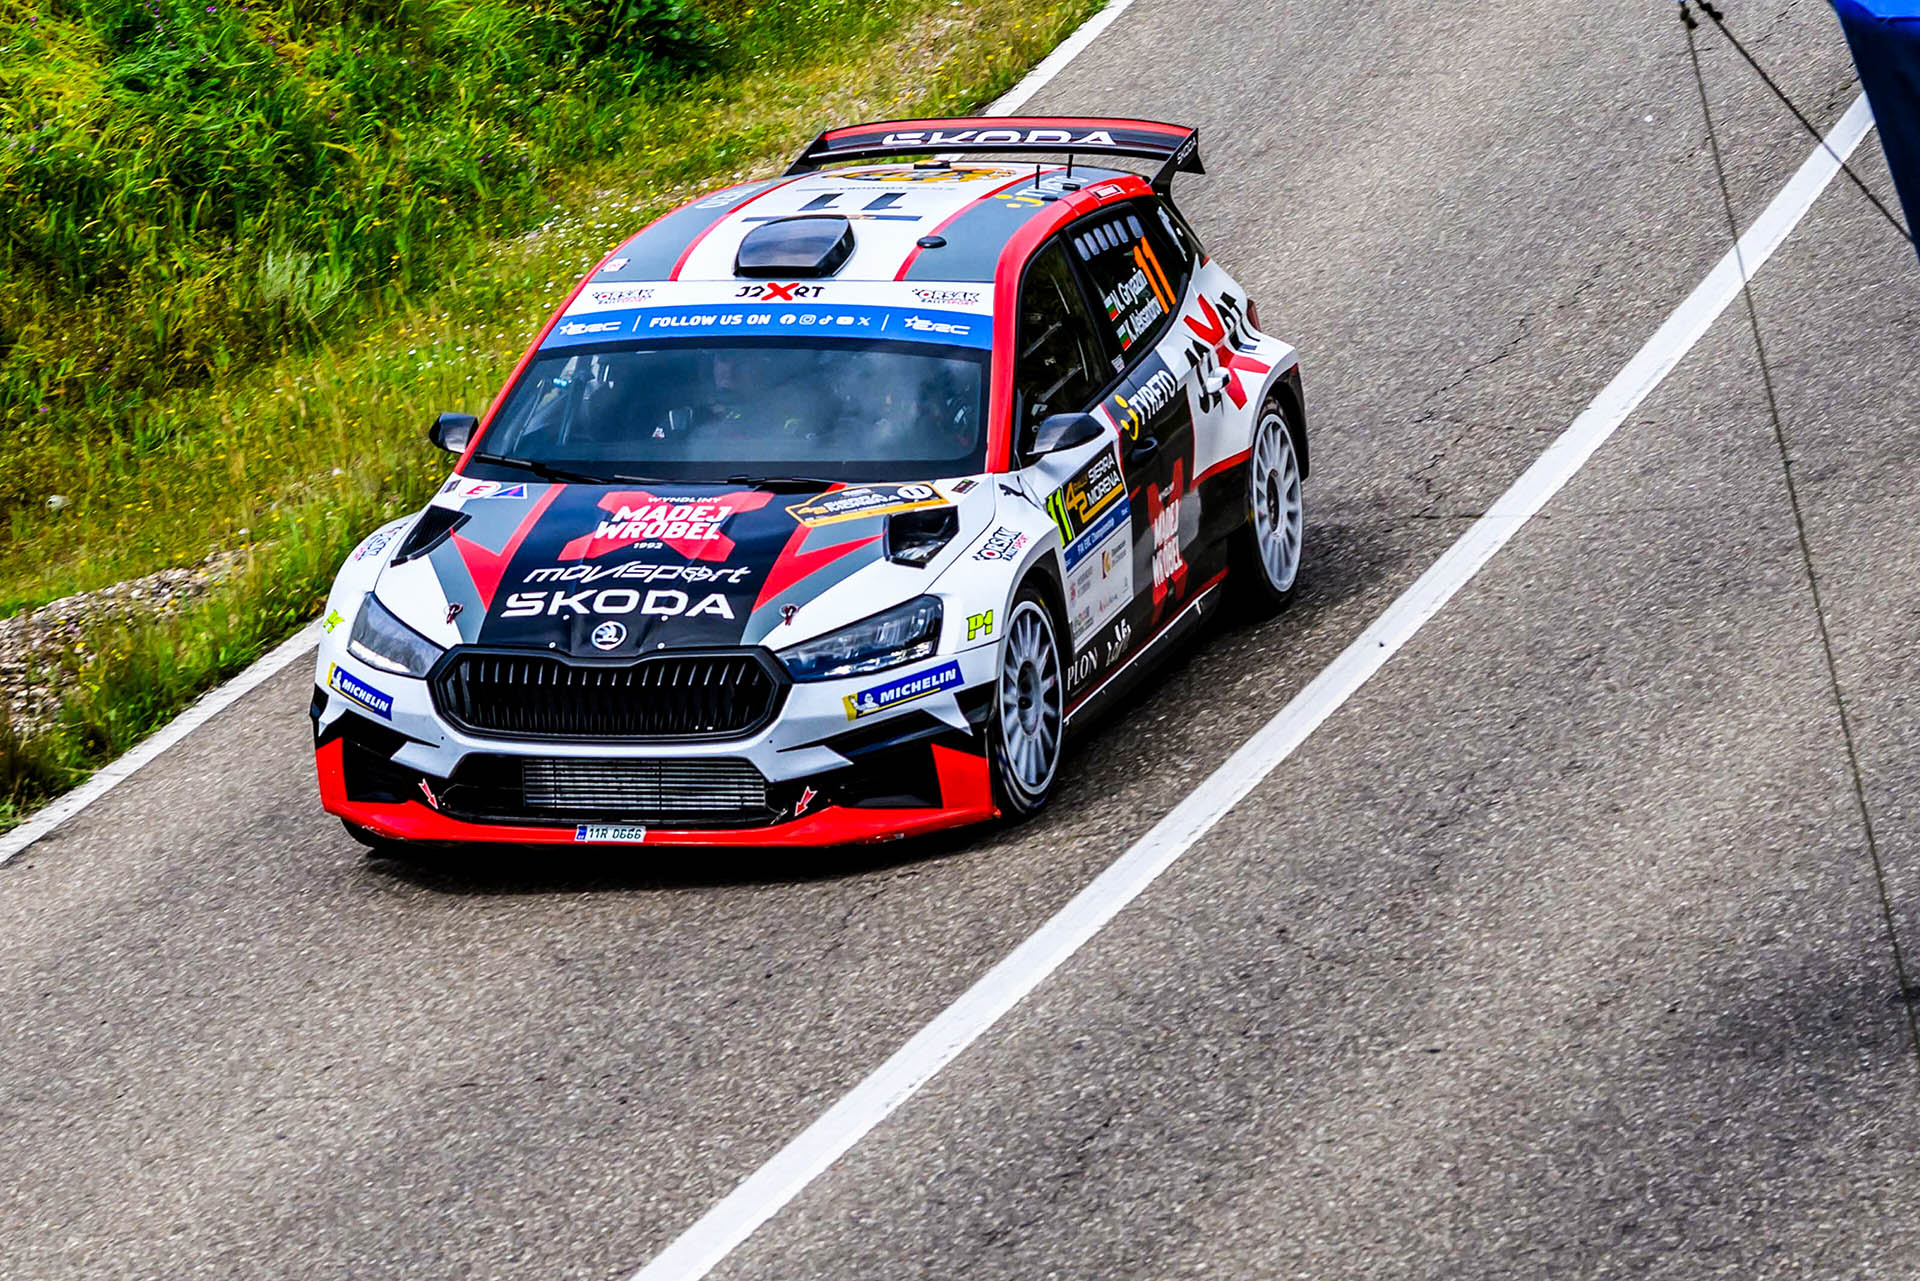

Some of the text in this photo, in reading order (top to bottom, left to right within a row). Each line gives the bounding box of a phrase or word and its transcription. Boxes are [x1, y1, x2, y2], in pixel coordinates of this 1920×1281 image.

[1176, 137, 1197, 165] SKODA
[1133, 235, 1176, 314] 11
[649, 314, 771, 328] FOLLOW US ON
[1128, 370, 1177, 425] TYRETO
[1088, 452, 1116, 485] SIERRA
[648, 496, 723, 504] WYNDLINY
[905, 488, 925, 497] 11
[1087, 470, 1121, 507] MORENA
[611, 505, 733, 523] MADEJ
[1046, 488, 1074, 548] 11
[500, 589, 735, 620] SKODA
[966, 609, 994, 641] P1
[1067, 646, 1098, 691] PLON
[341, 678, 389, 713] MICHELIN
[879, 668, 957, 703] MICHELIN
